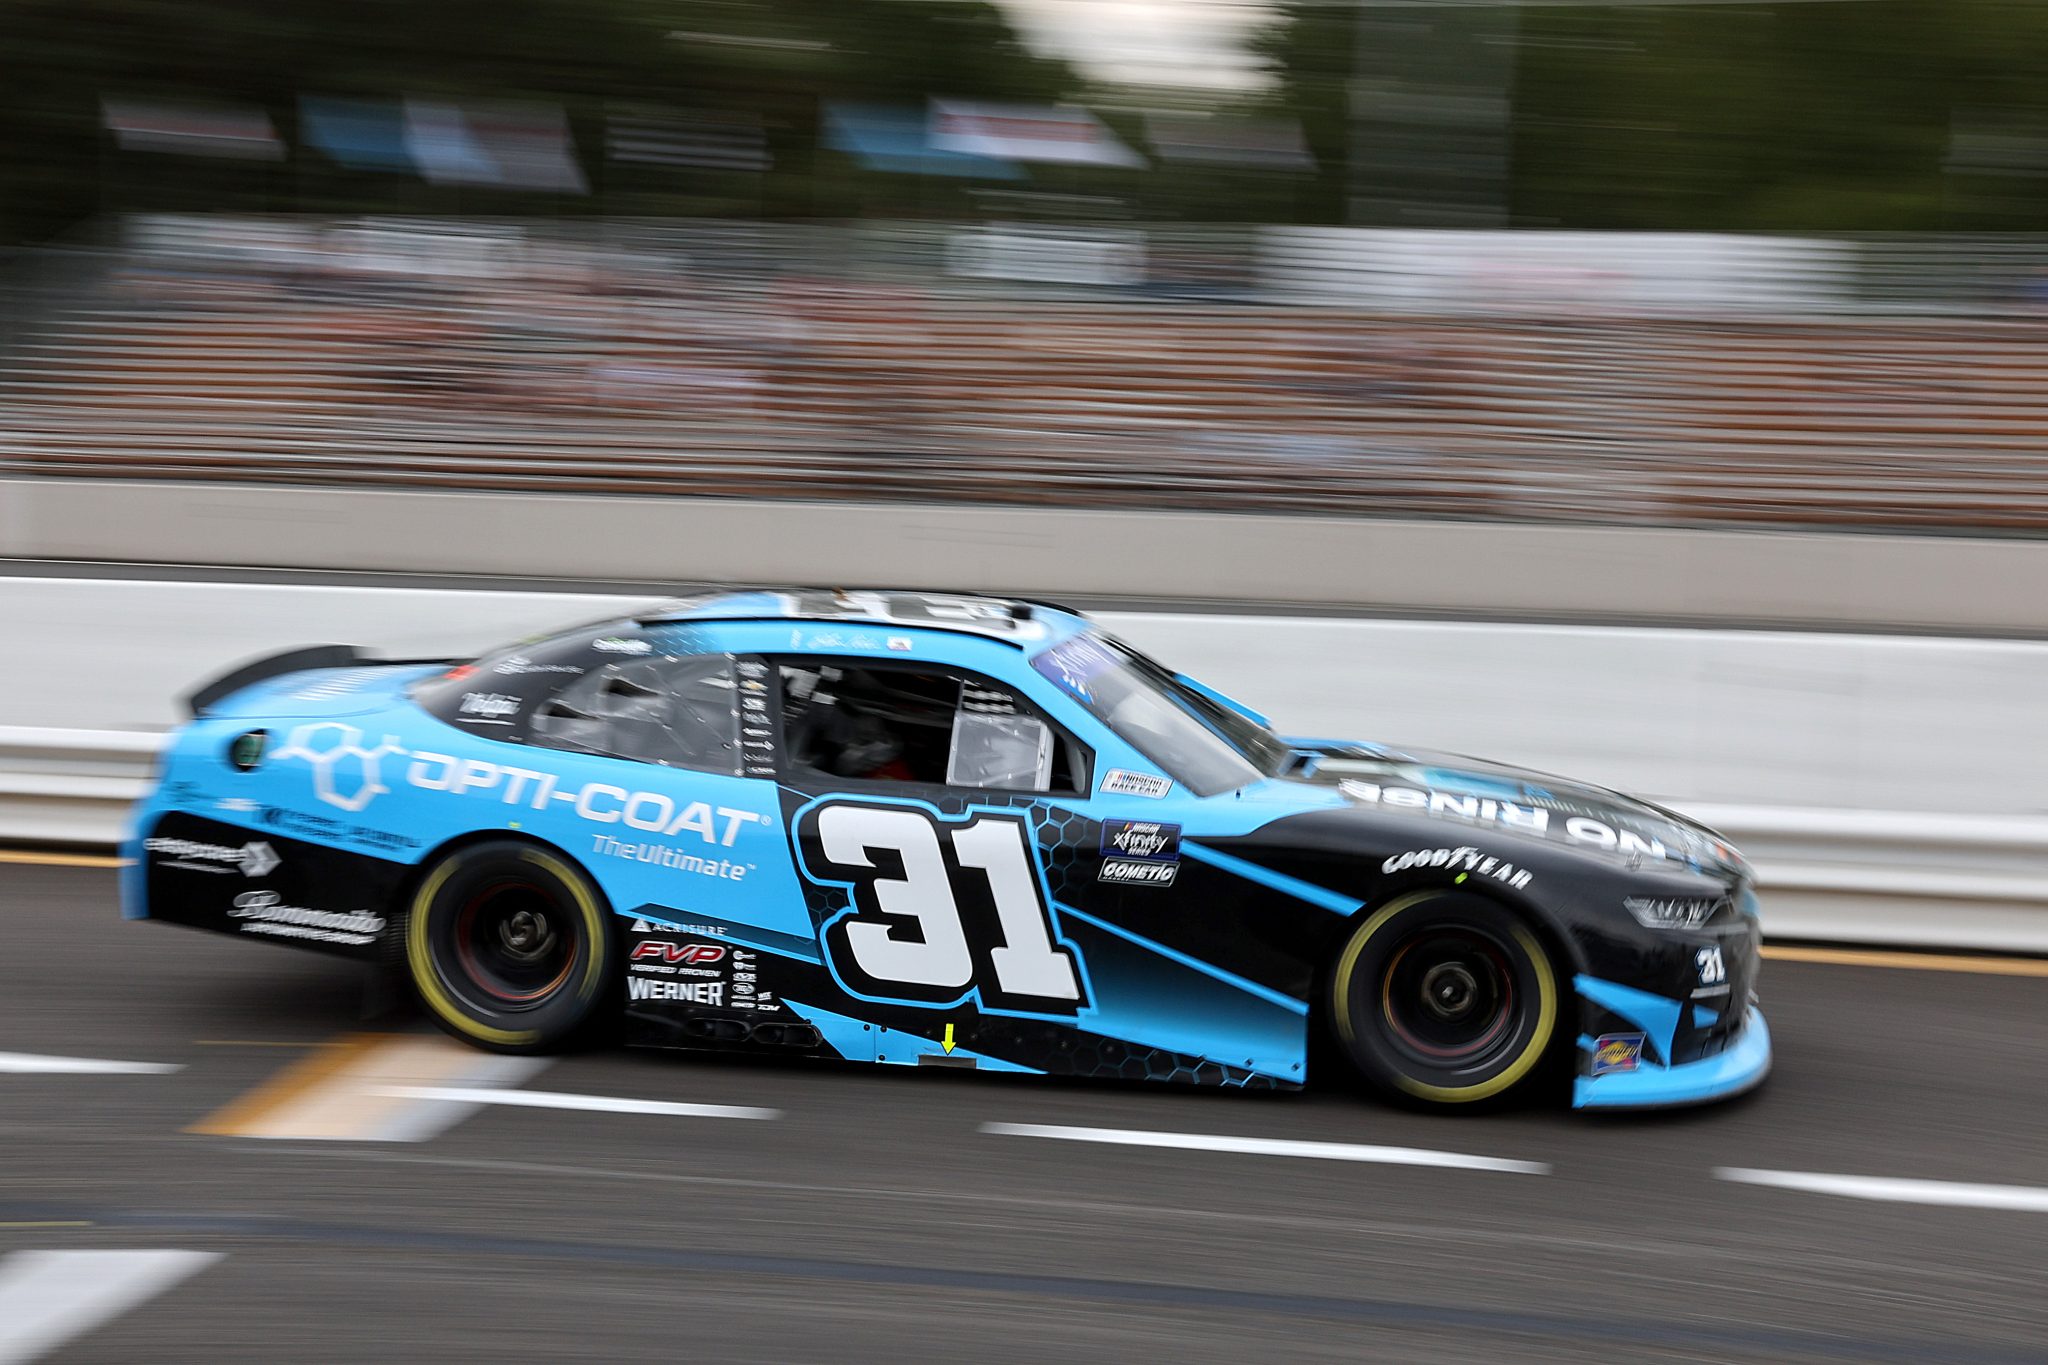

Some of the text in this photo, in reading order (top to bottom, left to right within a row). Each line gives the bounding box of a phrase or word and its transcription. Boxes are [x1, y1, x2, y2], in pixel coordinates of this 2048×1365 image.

[1338, 778, 1667, 861] NO RINSE
[1381, 845, 1534, 890] GOODYEAR
[816, 804, 1082, 1002] 31
[652, 922, 726, 936] ACRISURE
[629, 940, 726, 965] FVP
[1696, 947, 1725, 984] 31
[626, 976, 726, 1007] WERNER
